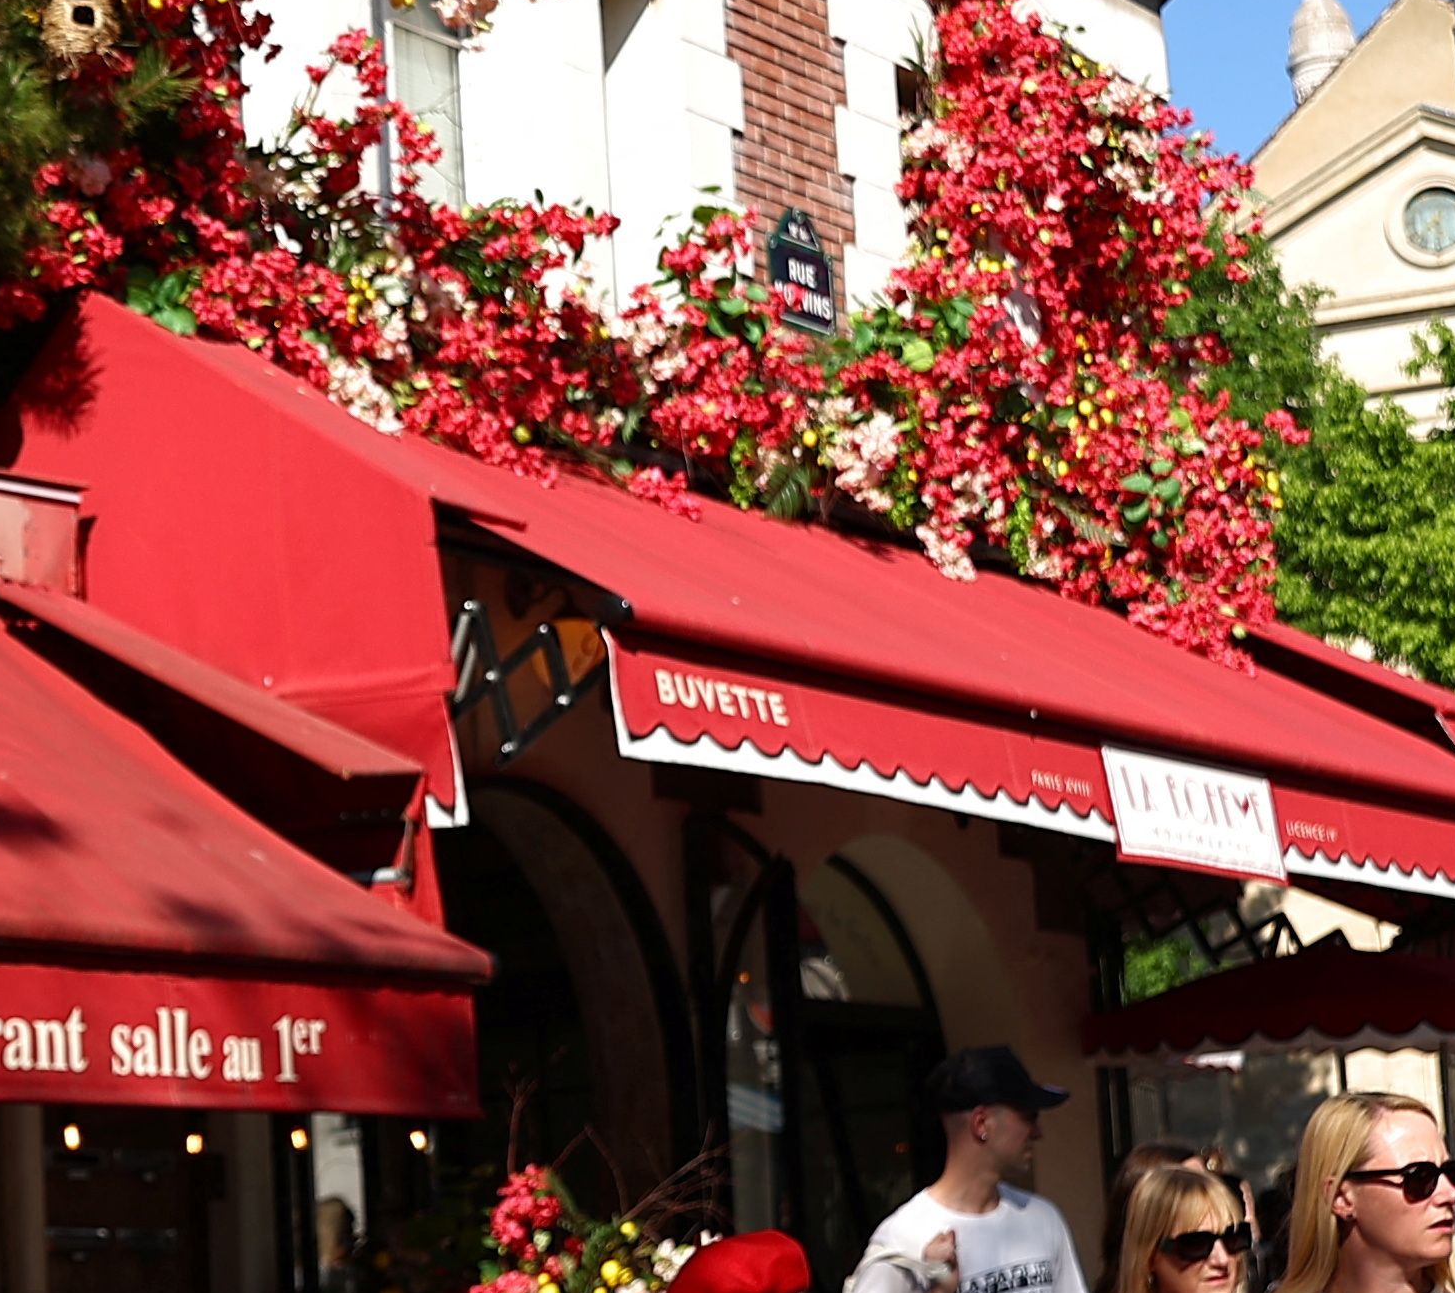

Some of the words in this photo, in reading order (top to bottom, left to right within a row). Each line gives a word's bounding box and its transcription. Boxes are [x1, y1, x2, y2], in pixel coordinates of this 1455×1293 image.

[788, 257, 817, 289] RUE
[654, 668, 791, 727] BUVETTE
[1030, 768, 1064, 793] PARIS
[1285, 818, 1326, 843] LICENCE
[109, 1005, 212, 1081] salle
[222, 1032, 263, 1083] au
[271, 1012, 326, 1084] 1er
